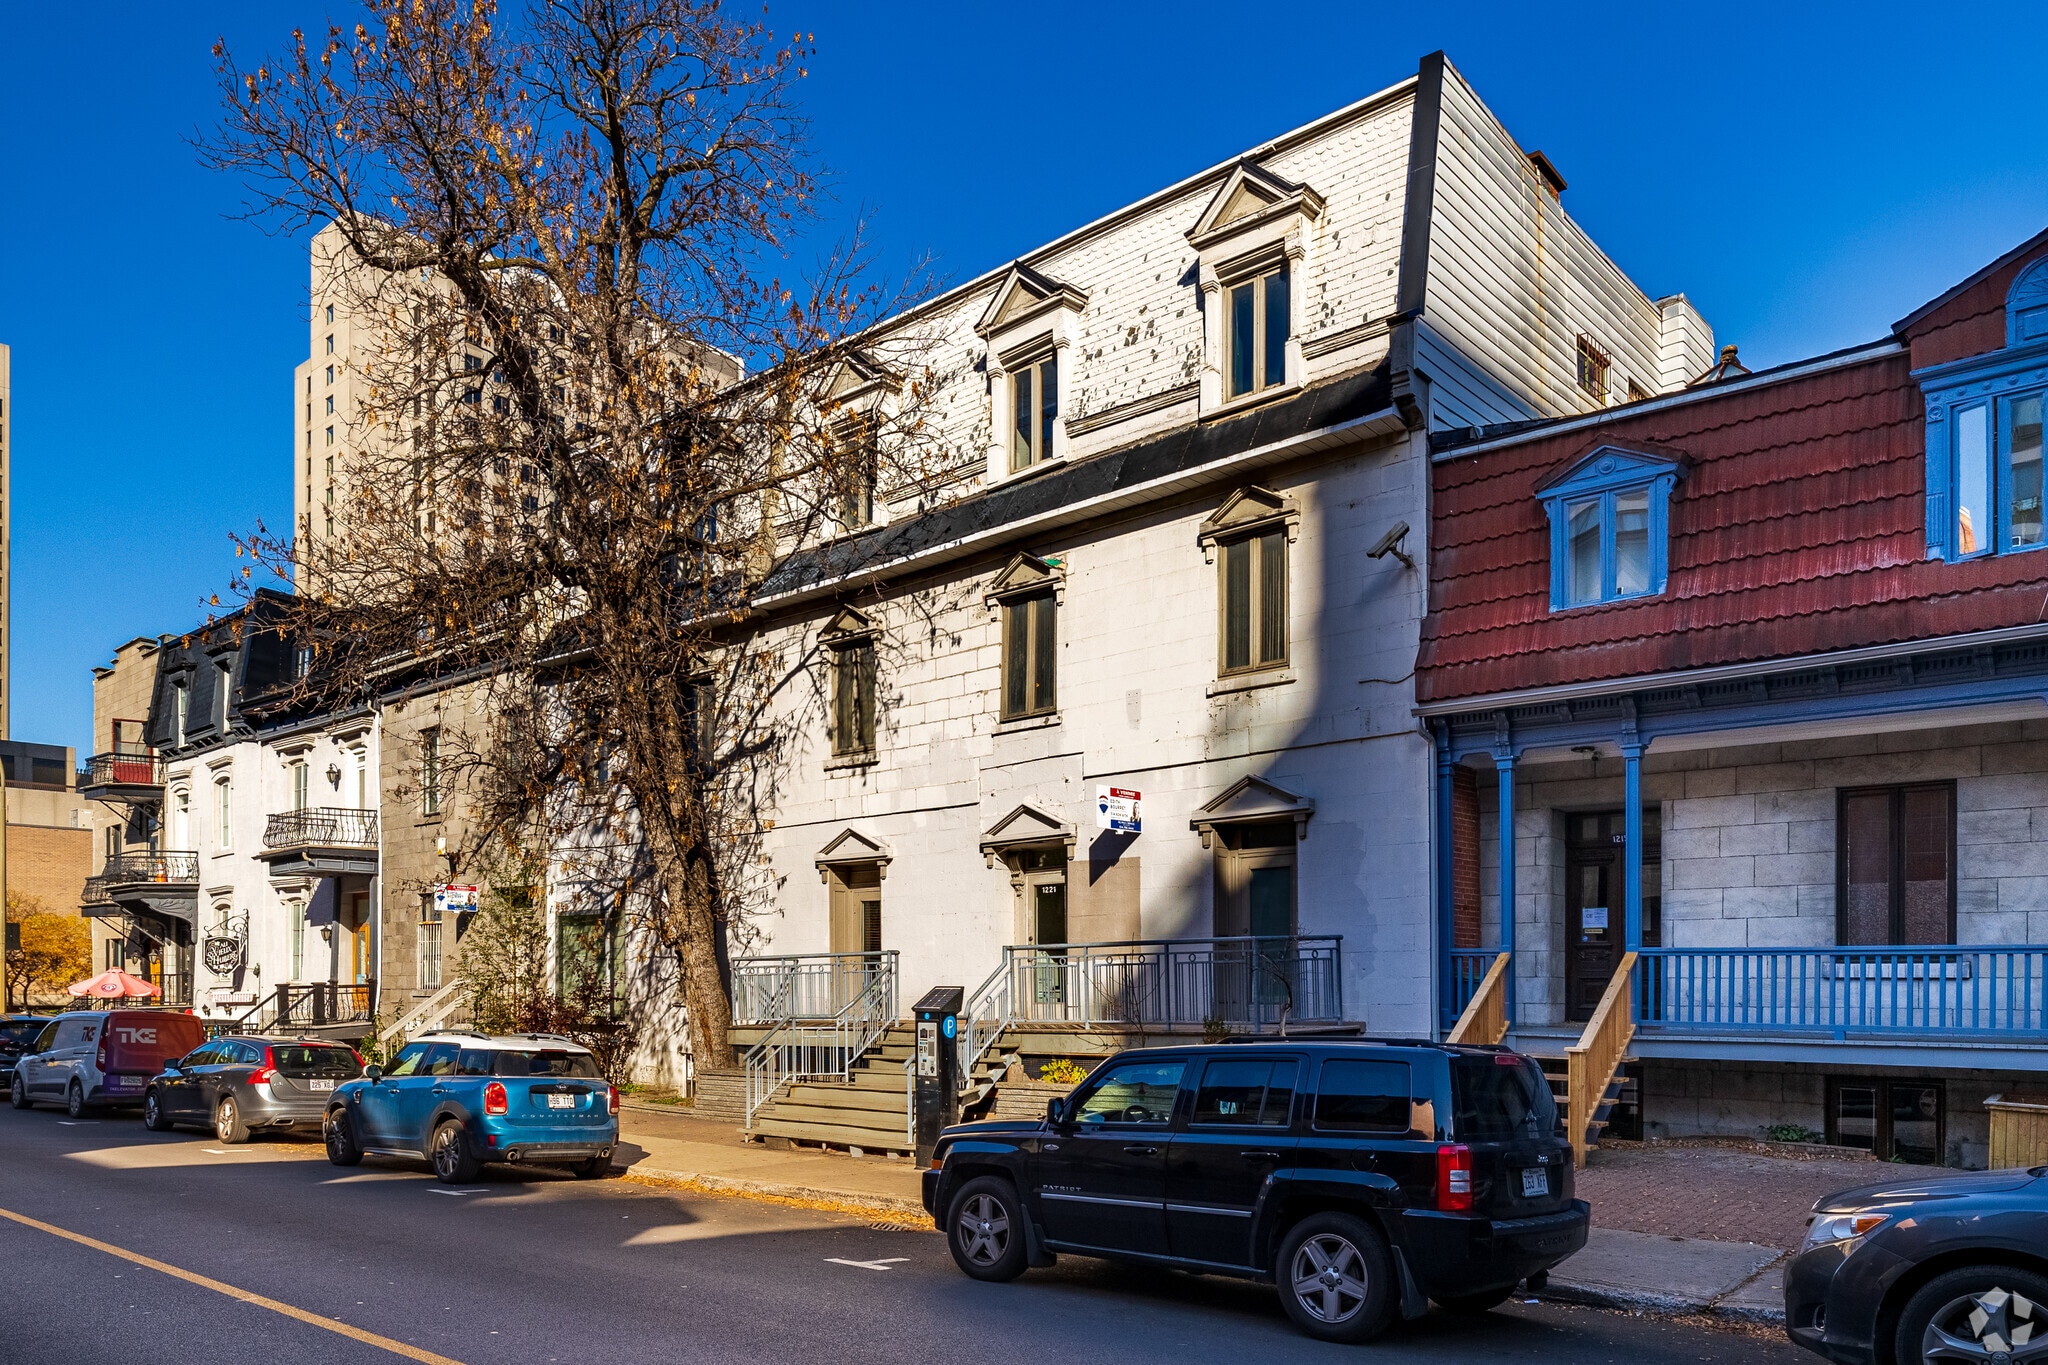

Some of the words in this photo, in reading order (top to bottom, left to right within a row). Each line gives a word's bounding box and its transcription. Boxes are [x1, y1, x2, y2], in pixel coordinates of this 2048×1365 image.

[1041, 886, 1057, 894] 1221
[81, 1026, 97, 1042] TKE
[947, 1019, 954, 1034] P
[115, 1027, 157, 1044] TKE
[1042, 1184, 1082, 1192] PATRIOT
